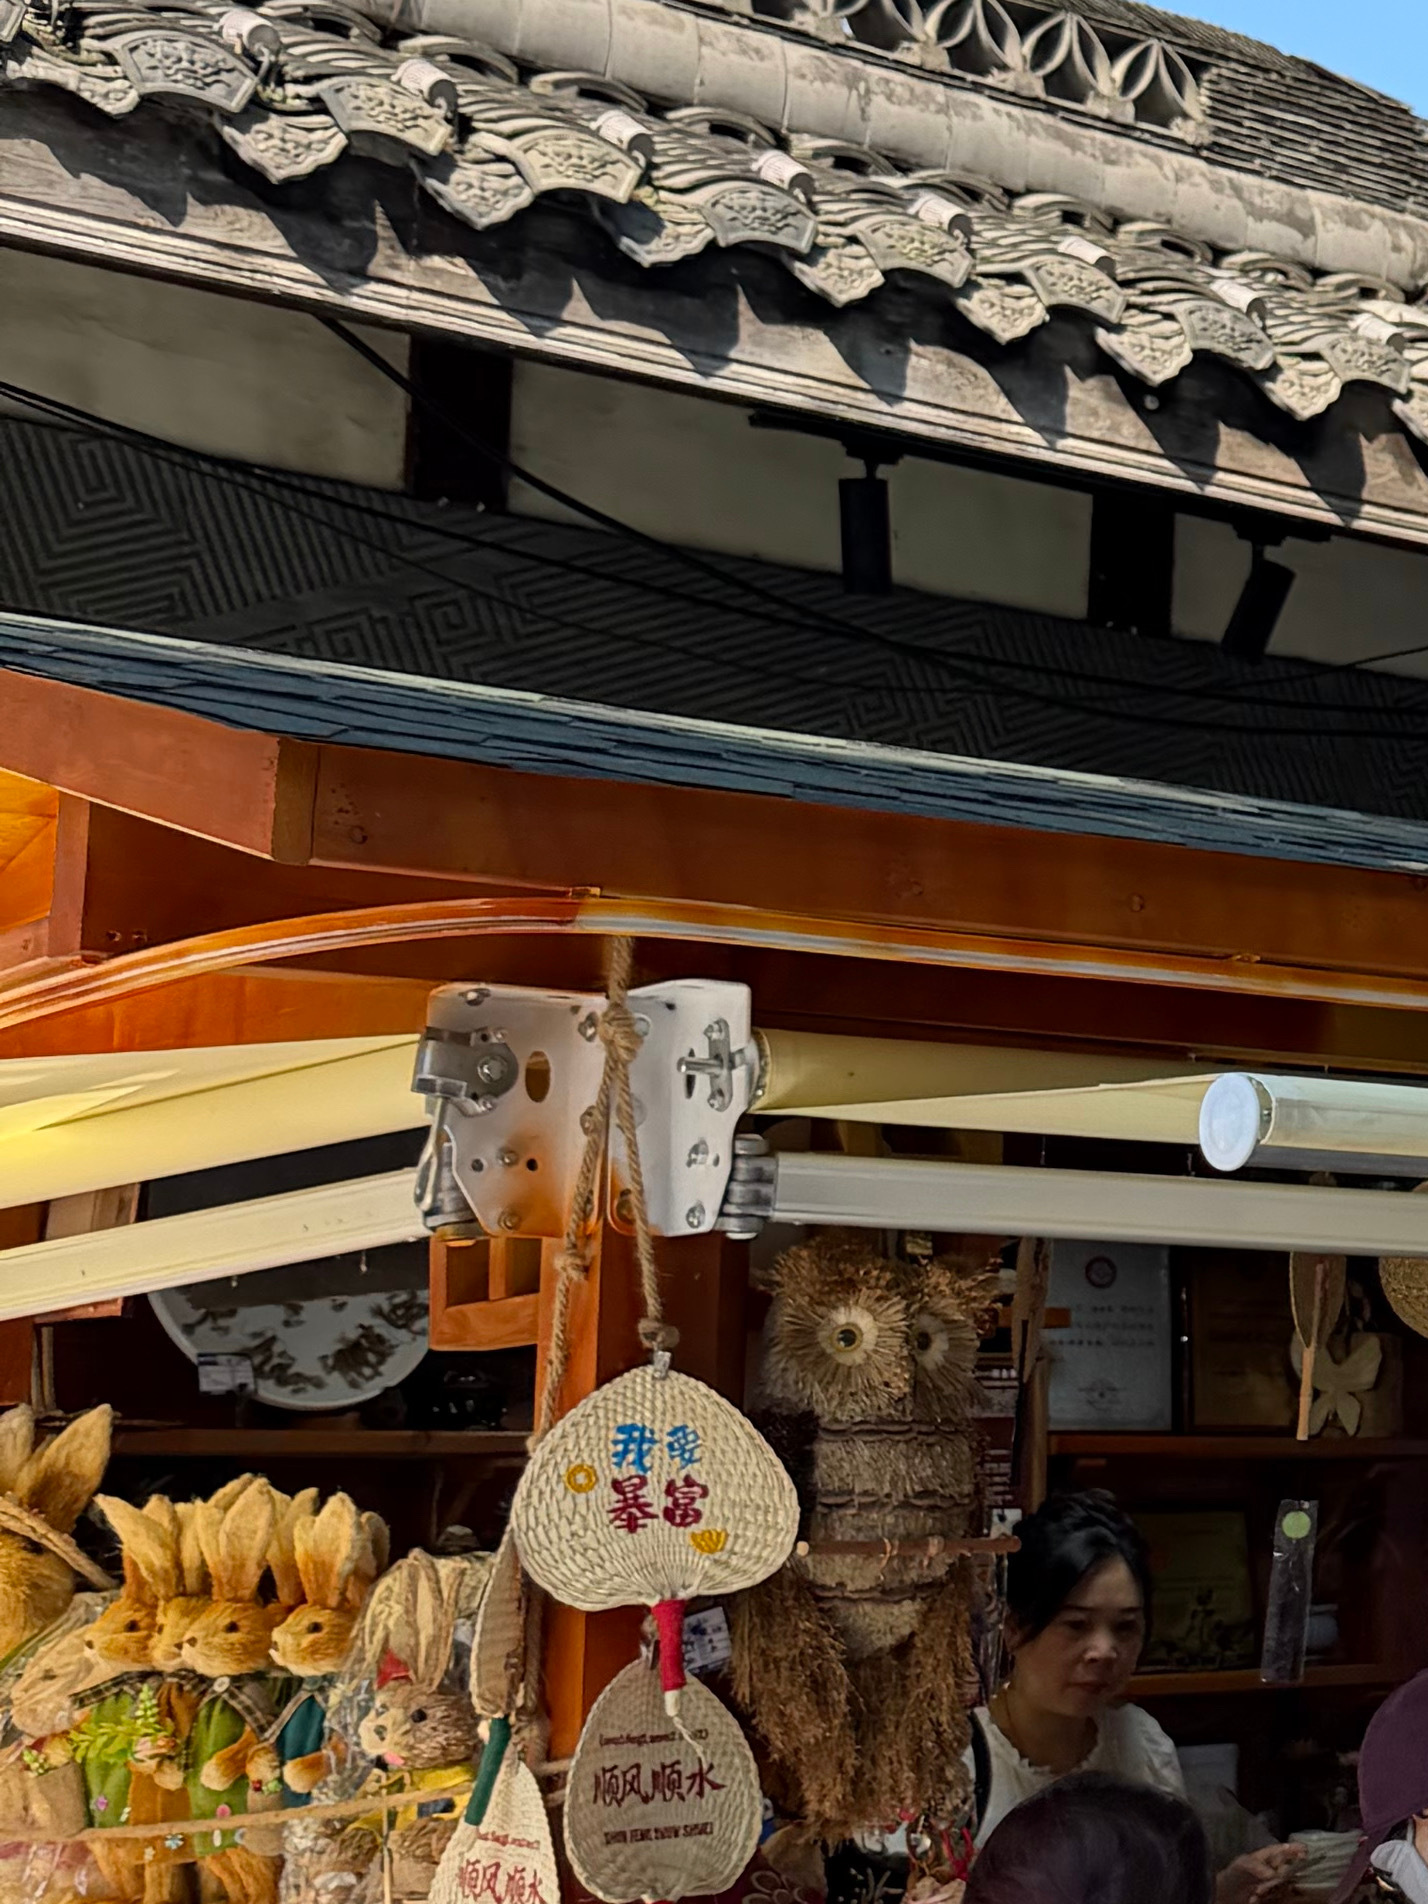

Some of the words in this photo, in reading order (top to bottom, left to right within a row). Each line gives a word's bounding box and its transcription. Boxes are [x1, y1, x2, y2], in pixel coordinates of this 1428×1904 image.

[610, 1422, 703, 1475] 我要
[605, 1473, 710, 1534] 暴富
[592, 1756, 727, 1808] 顺风顺水
